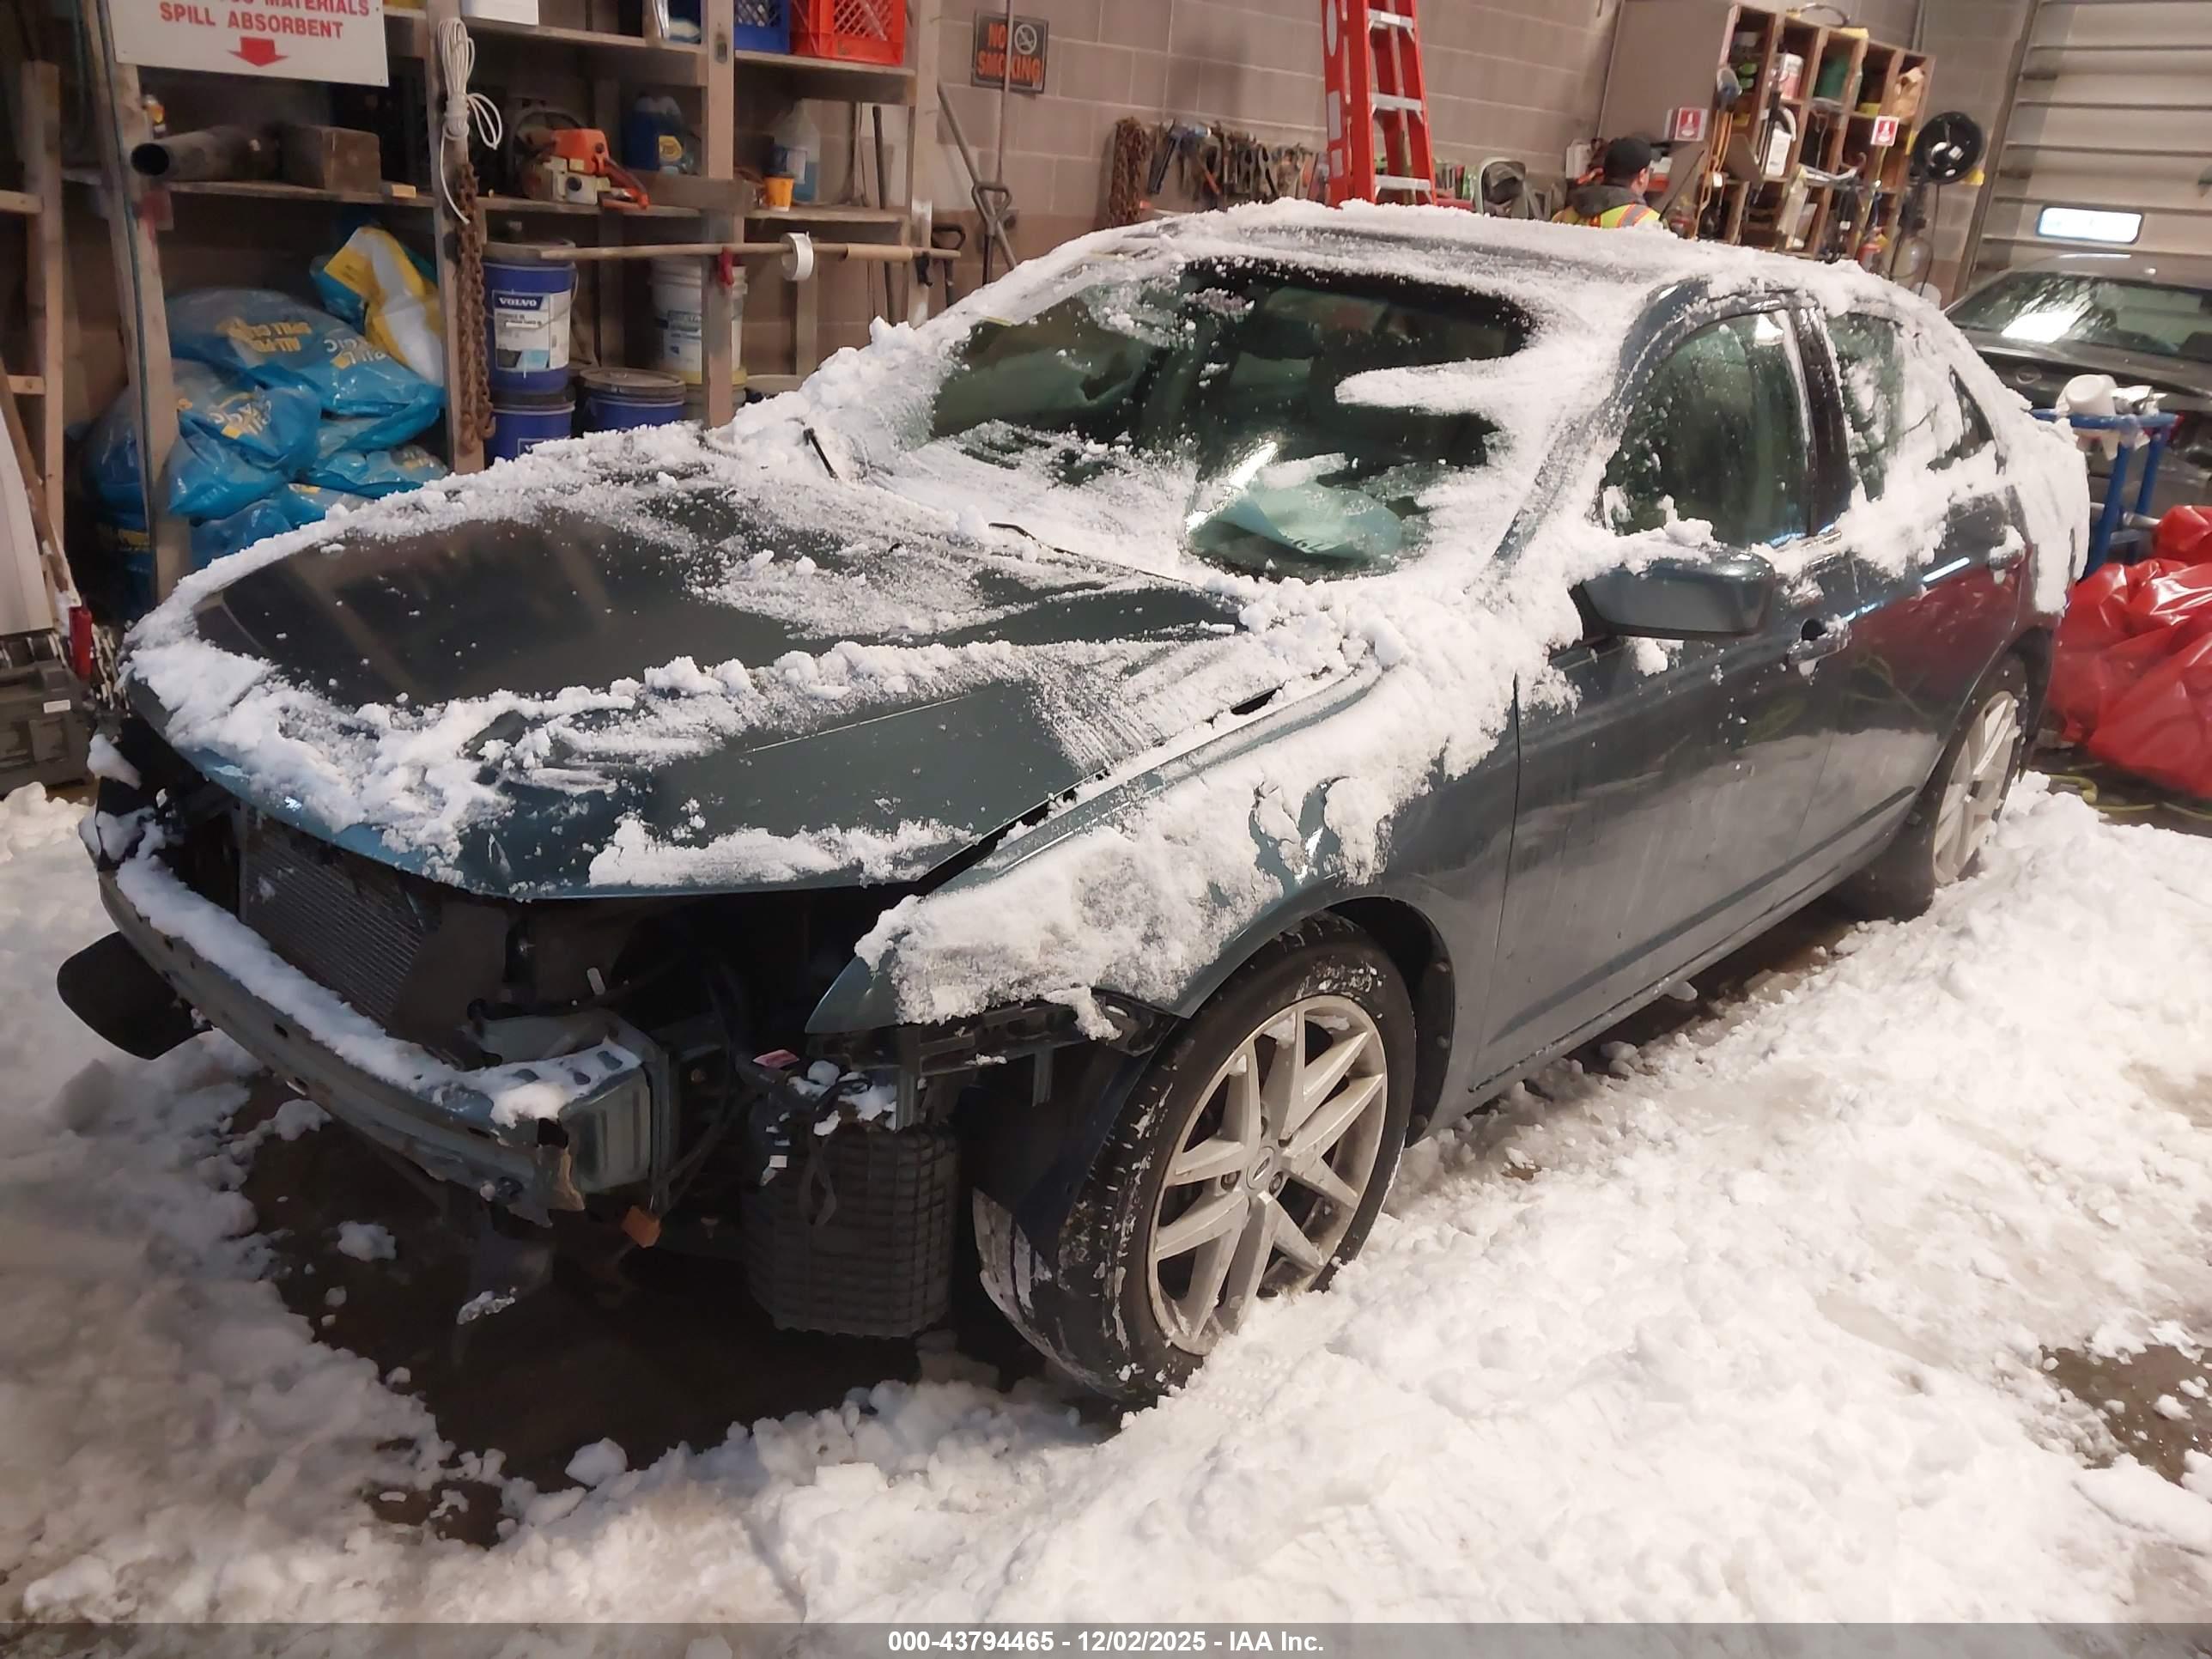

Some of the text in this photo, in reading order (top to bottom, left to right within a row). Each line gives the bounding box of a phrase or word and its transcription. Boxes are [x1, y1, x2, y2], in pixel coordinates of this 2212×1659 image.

[160, 2, 343, 40] SPILL ABSORBENT
[988, 22, 1008, 50] NO
[978, 51, 1042, 83] SMOKING
[499, 296, 538, 307] VOLVO
